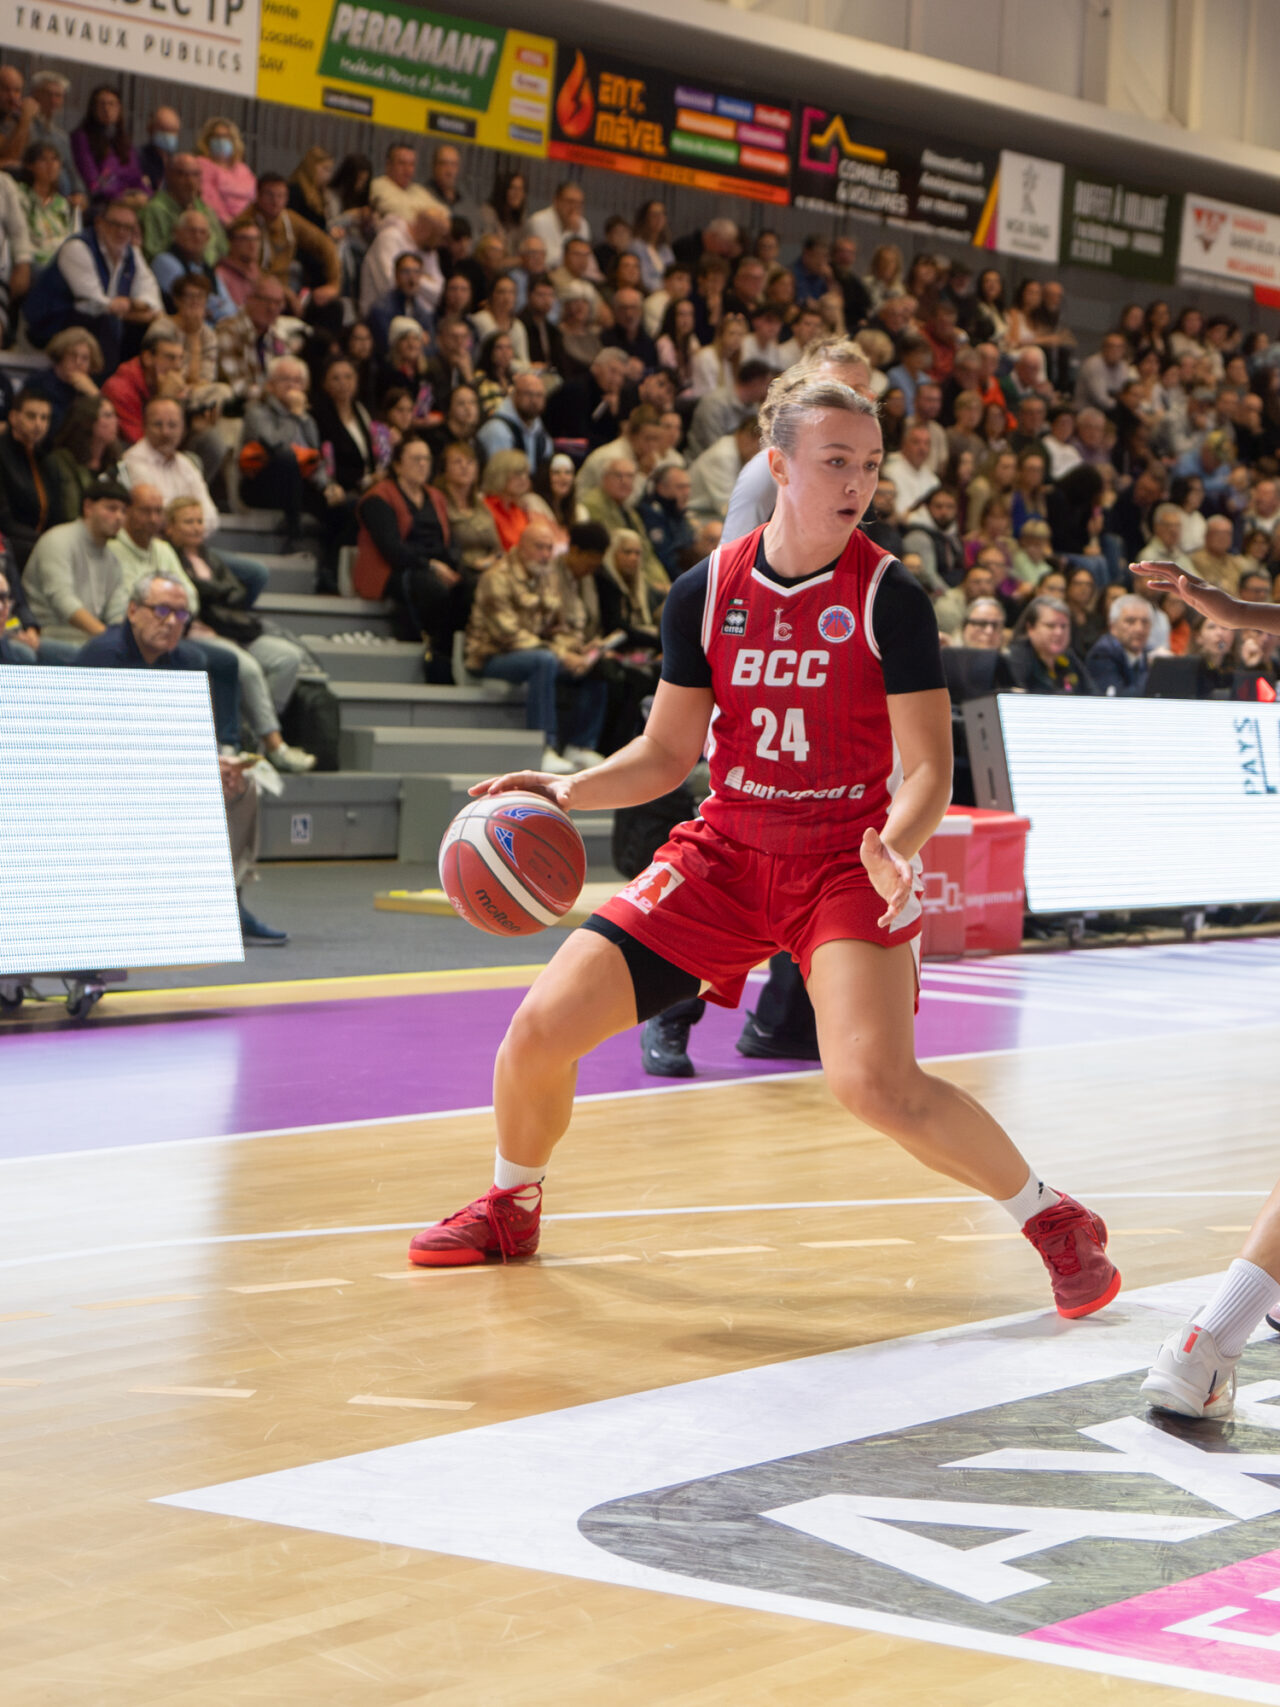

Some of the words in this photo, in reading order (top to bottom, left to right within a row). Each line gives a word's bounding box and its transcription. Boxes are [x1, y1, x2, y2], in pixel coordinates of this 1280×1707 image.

[15, 5, 128, 49] TRAVAUX
[143, 33, 243, 73] PUBLICS
[330, 2, 498, 79] PERRAMANT
[731, 649, 830, 688] BCC
[751, 707, 810, 762] 24
